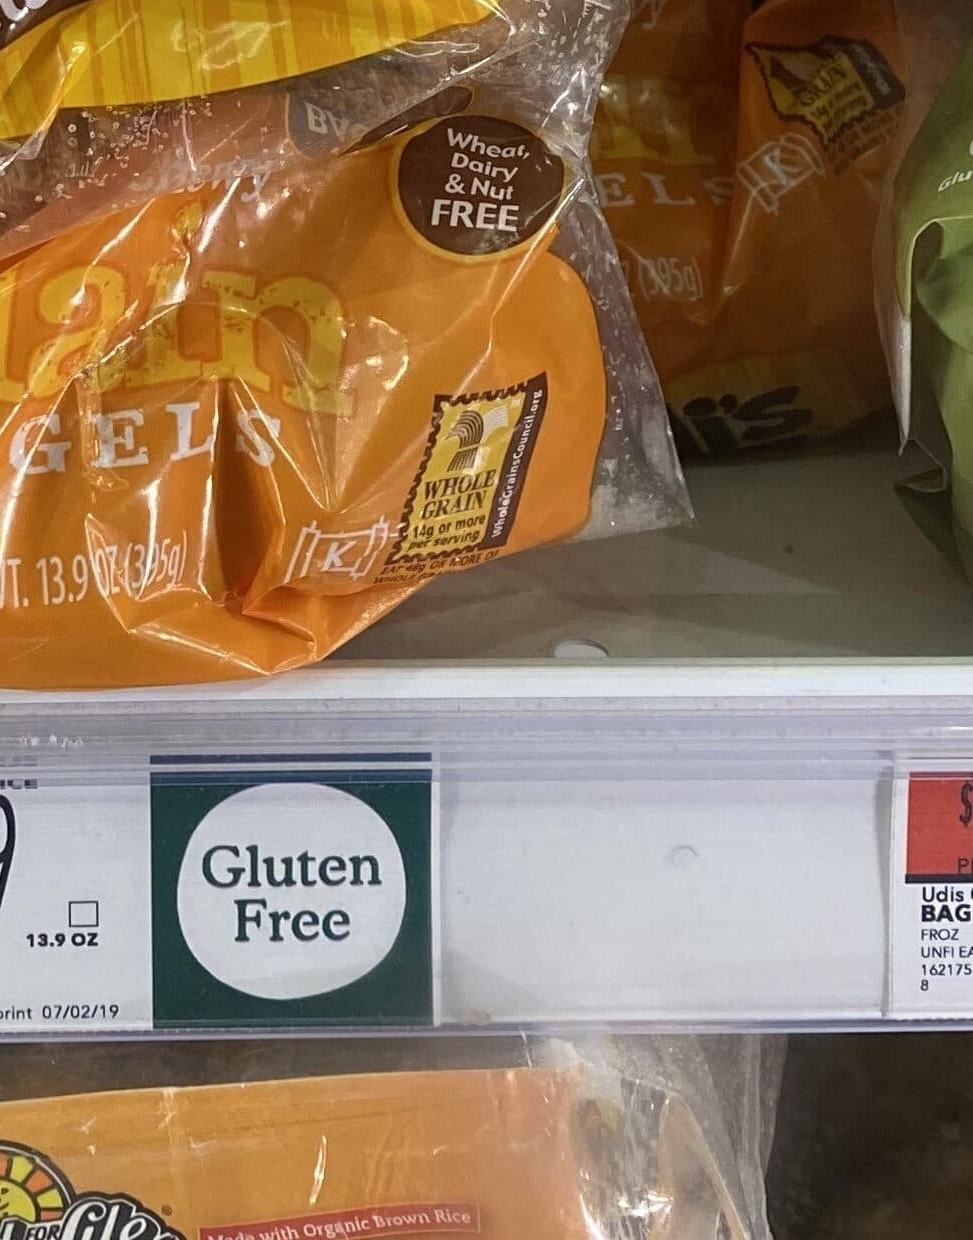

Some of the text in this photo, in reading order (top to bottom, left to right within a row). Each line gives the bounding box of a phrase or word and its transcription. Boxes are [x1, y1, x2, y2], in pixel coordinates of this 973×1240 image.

[447, 127, 530, 160] Wheat,
[451, 152, 518, 183] Dairy
[444, 173, 515, 201] & Nut
[430, 199, 520, 233] FREE
[425, 468, 497, 501] WHOLE
[421, 490, 487, 520] GRAIN
[413, 514, 486, 539] 14g or more
[406, 529, 480, 552] per serving
[35, 554, 88, 606] 13.9
[92, 545, 122, 596] OZ
[201, 844, 382, 889] Gluten
[922, 885, 964, 902] Udis
[233, 897, 351, 943] Free
[921, 904, 972, 922] BAG
[26, 933, 99, 948] 13.9 OZ
[921, 928, 959, 940] FROZ
[921, 946, 954, 959] UNFI
[922, 963, 972, 976] 162175
[920, 978, 929, 991] 8
[41, 1004, 120, 1020] 07/02/19
[260, 1227, 299, 1240] with
[305, 1216, 370, 1239] Organic
[373, 1211, 430, 1227] Brown
[434, 1209, 472, 1224] Rice
